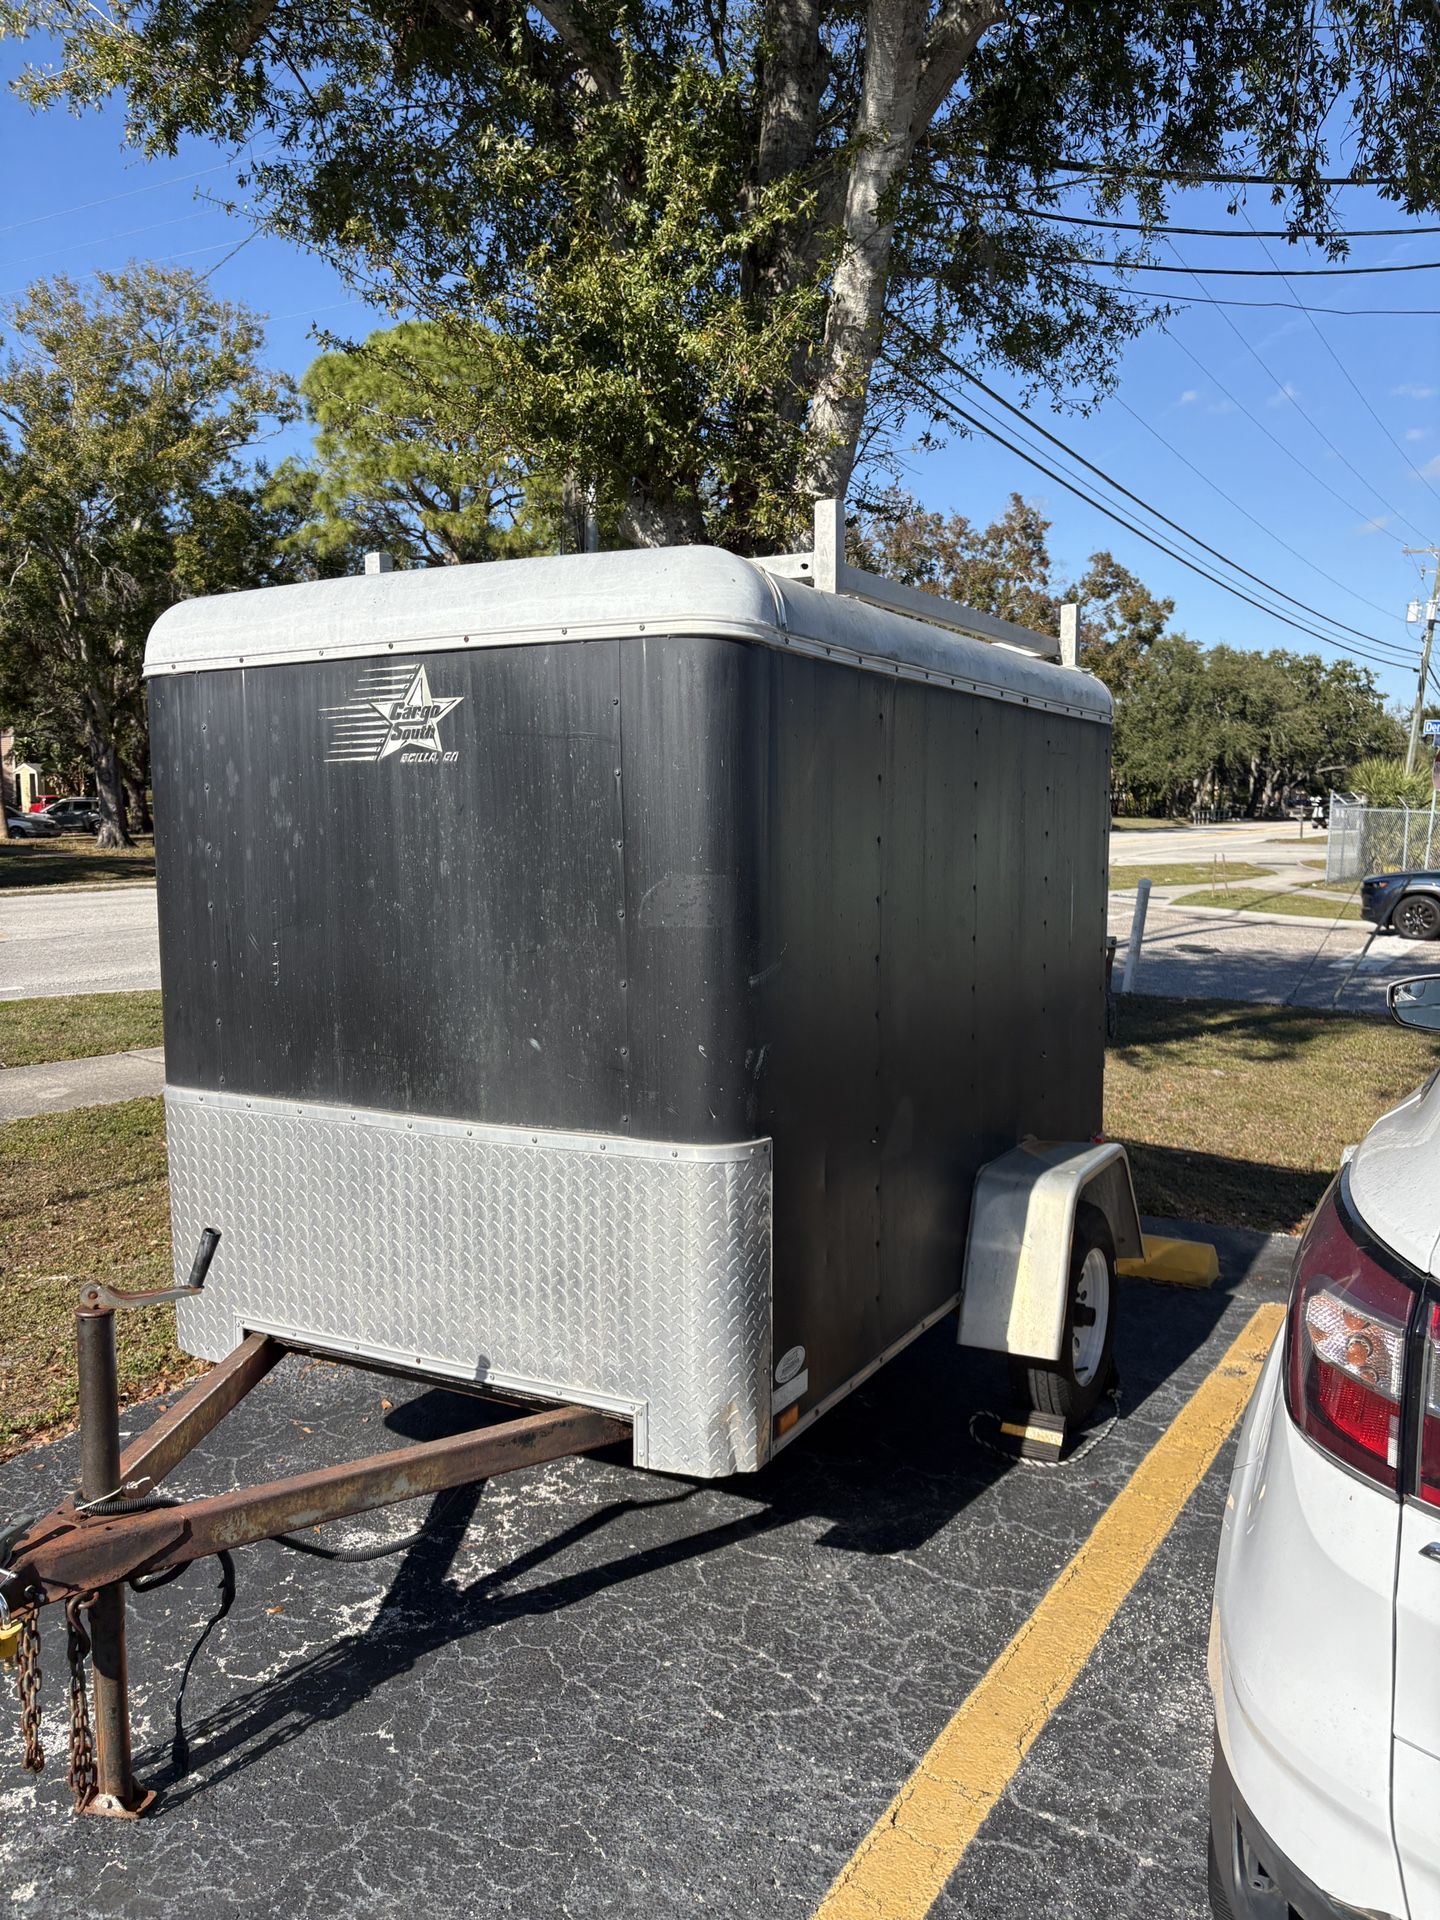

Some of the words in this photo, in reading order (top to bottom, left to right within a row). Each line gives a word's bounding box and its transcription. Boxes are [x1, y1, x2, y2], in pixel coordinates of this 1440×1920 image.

[390, 702, 441, 724] Cargo
[391, 721, 436, 740] South
[442, 751, 459, 761] GA
